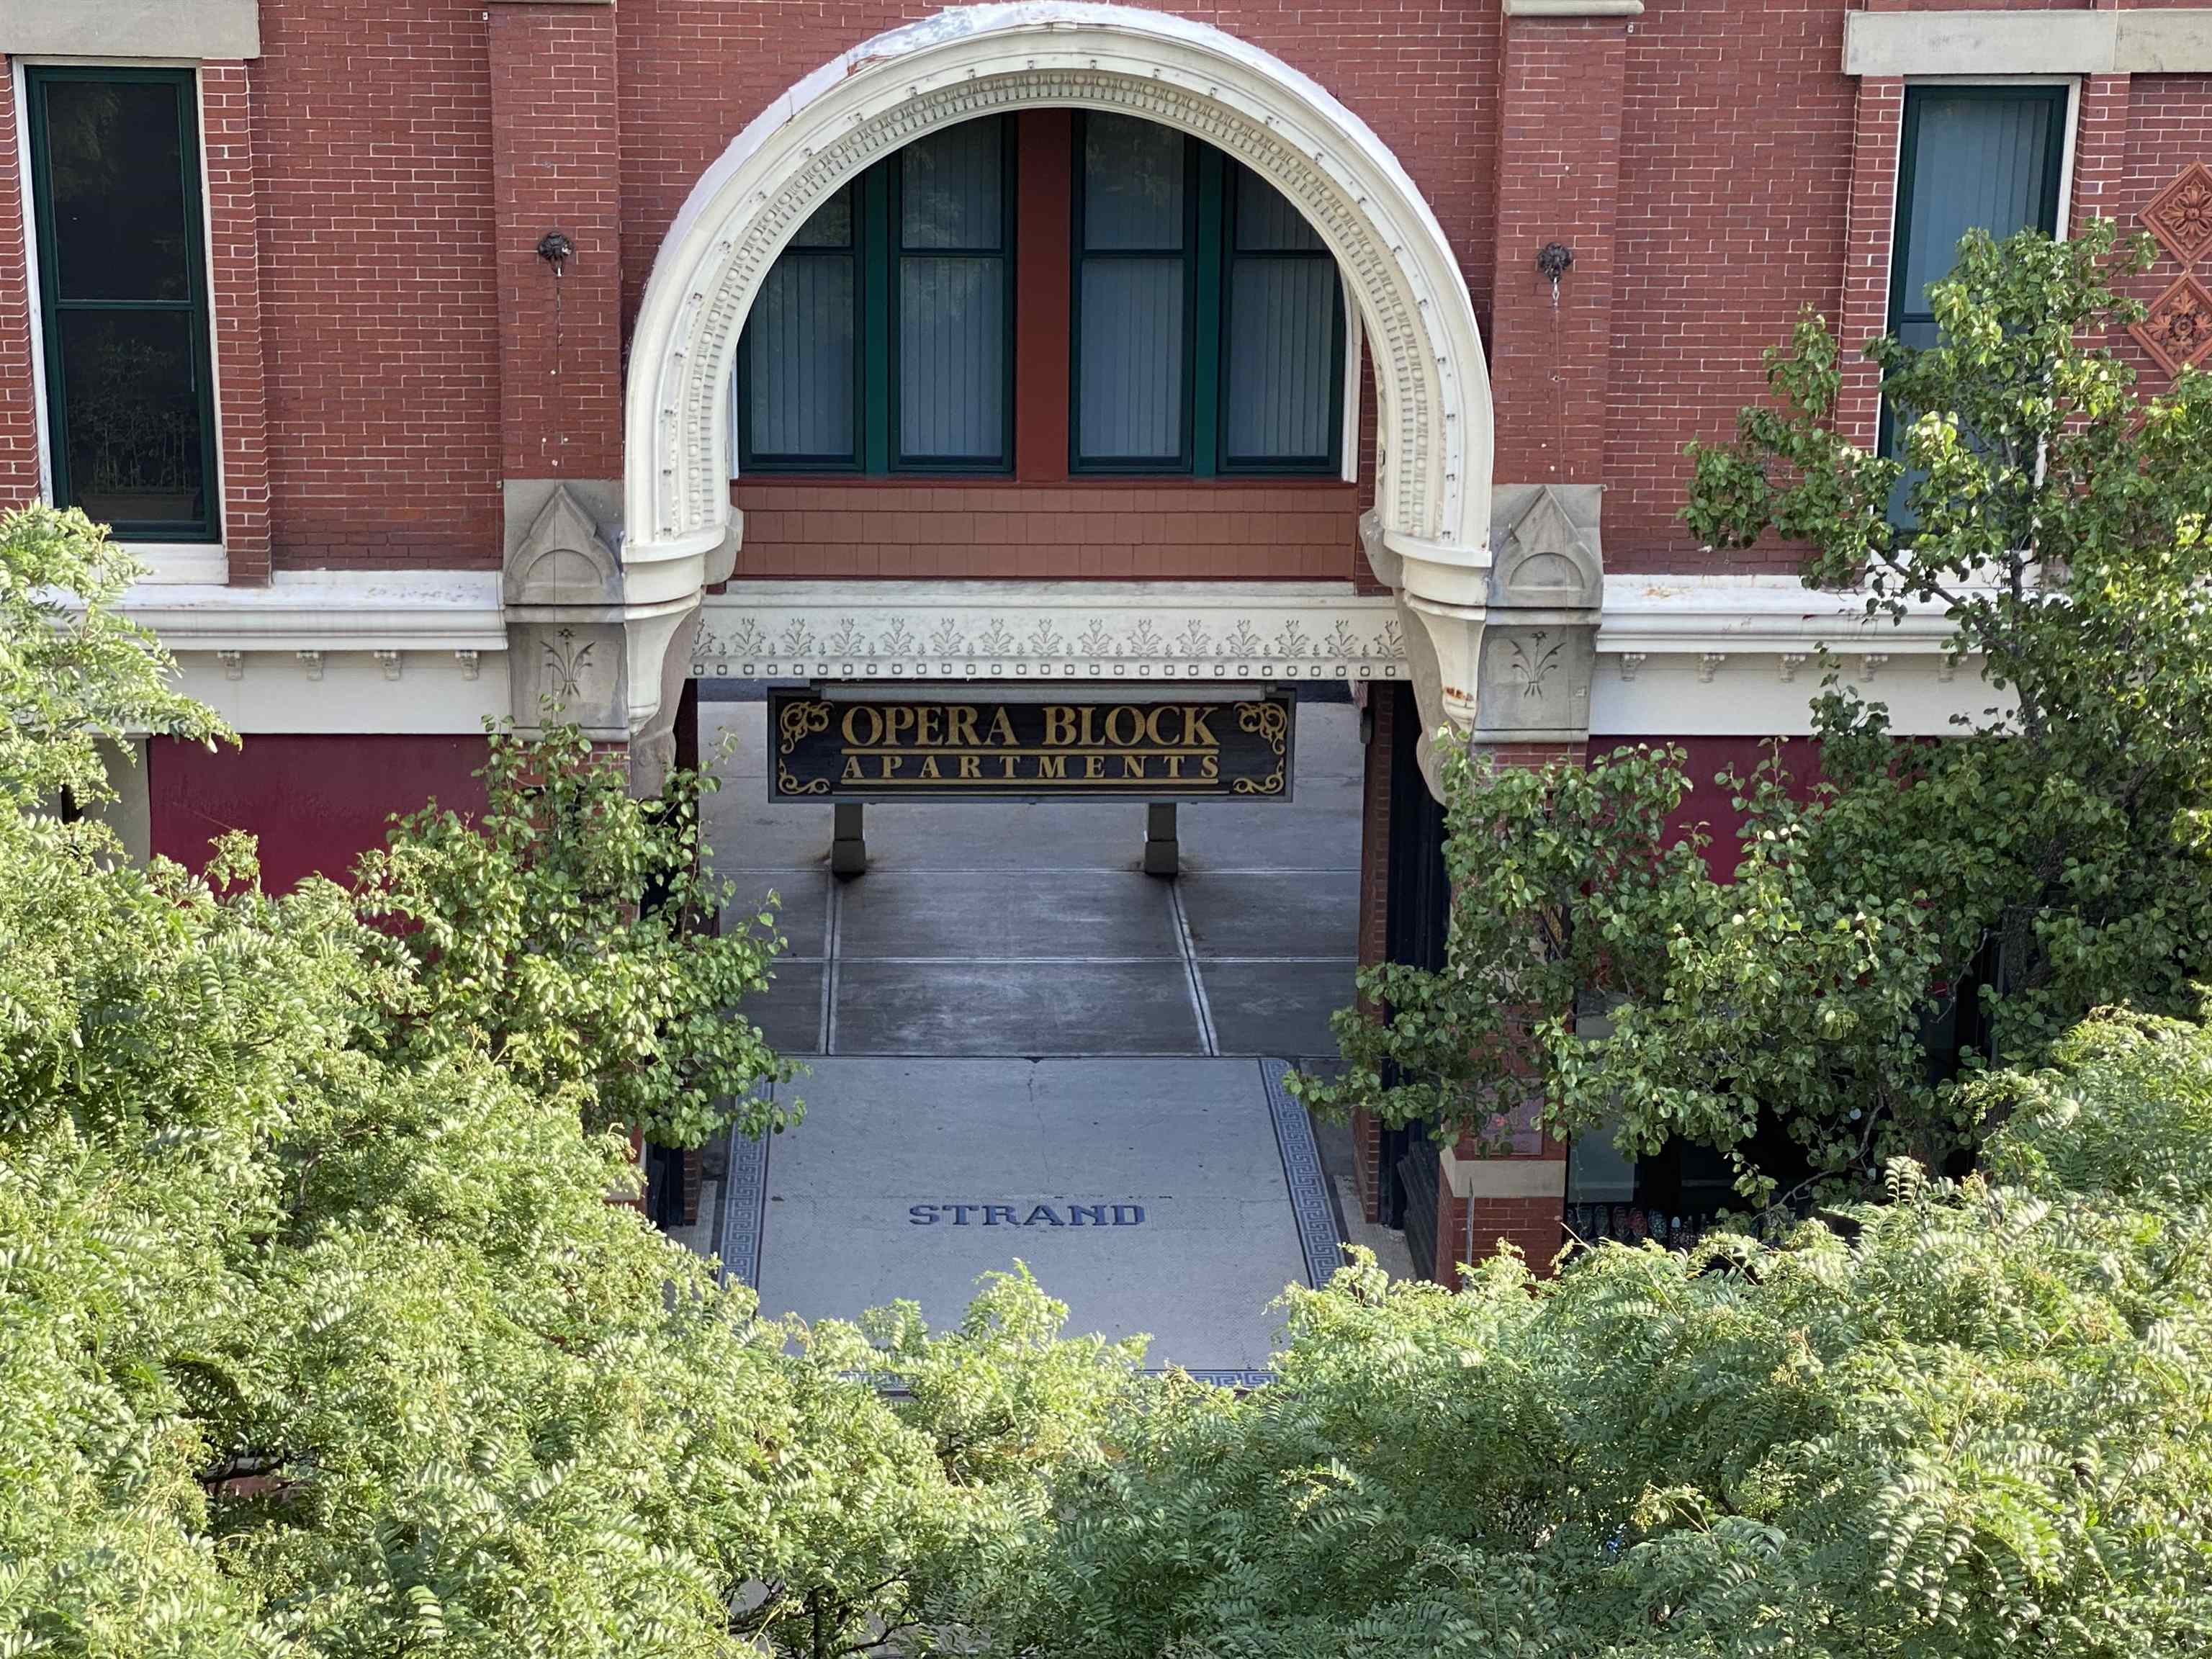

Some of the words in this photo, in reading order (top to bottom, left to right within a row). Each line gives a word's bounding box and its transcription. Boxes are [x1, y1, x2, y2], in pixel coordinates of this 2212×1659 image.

[841, 707, 1017, 746] OPERA
[1043, 707, 1220, 746] BLOCK
[841, 755, 1219, 778] APARTMENTS
[909, 1204, 1146, 1226] STRAND
